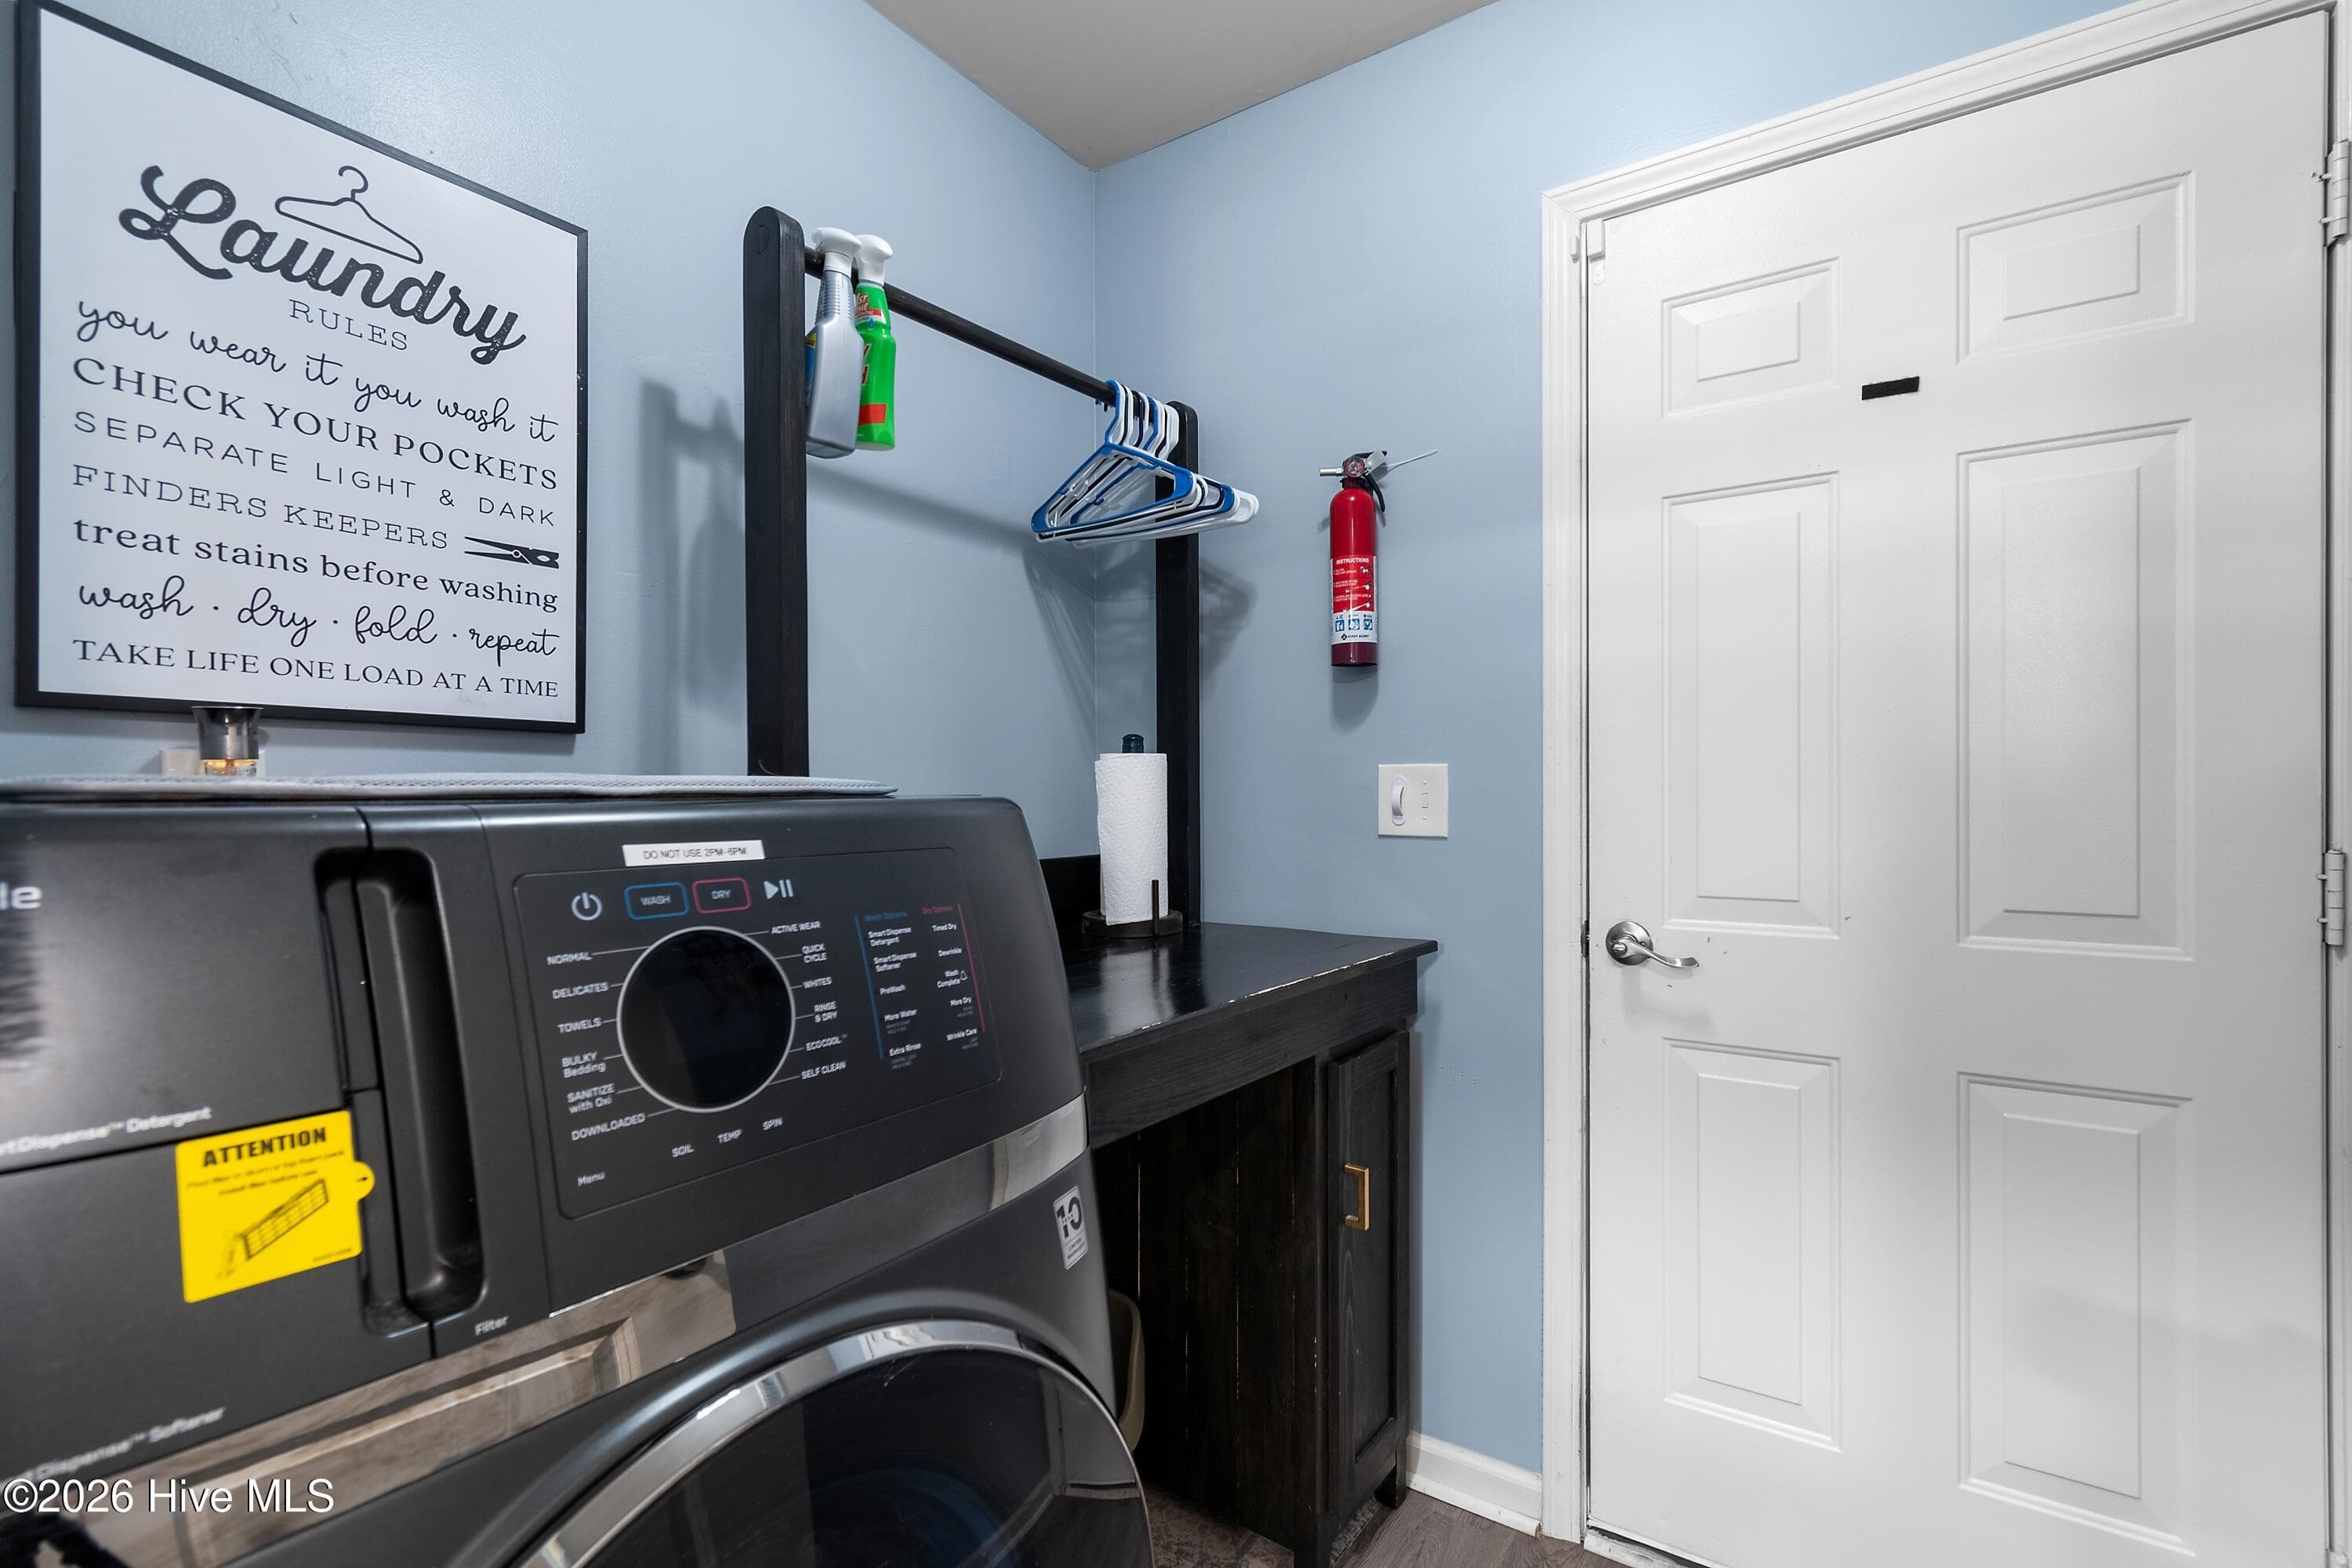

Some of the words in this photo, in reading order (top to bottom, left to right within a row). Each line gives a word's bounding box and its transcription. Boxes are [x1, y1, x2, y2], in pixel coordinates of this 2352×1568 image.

[118, 165, 526, 364] Laundry
[289, 299, 407, 350] RULES
[78, 301, 169, 342] you
[190, 330, 286, 373] wear
[306, 354, 343, 385] it
[354, 377, 422, 412] you
[437, 398, 515, 432] wash
[530, 415, 558, 441] it
[74, 358, 245, 419] CHECK
[263, 402, 379, 450] YOUR
[394, 434, 557, 489] POCKETS
[74, 412, 288, 473] SEPARATE
[317, 463, 416, 498] LIGHT
[440, 489, 455, 506] &
[480, 497, 554, 526] DARK
[74, 465, 267, 517] FINDERS
[284, 505, 448, 549] KEEPERS
[74, 520, 180, 555] treat
[195, 538, 308, 574] stains
[320, 555, 429, 590] before
[439, 579, 558, 613] washing
[79, 575, 194, 619] wash
[238, 587, 317, 647] dry
[355, 605, 437, 644] fold
[469, 629, 560, 667] repeat
[73, 640, 175, 666] TAKE
[187, 650, 259, 673] LIFE
[270, 658, 334, 680] ONE
[344, 664, 423, 686] LOAD
[433, 673, 466, 690] AT
[474, 676, 492, 691] A
[501, 678, 558, 697] TIME
[643, 851, 658, 859] DO
[661, 849, 681, 858] NOT
[684, 848, 702, 858] USE
[641, 895, 671, 906] WASH
[711, 890, 731, 899] DRY
[771, 924, 798, 935] ACTIVE
[799, 920, 821, 931] WEAR
[802, 943, 826, 954] QUICK
[869, 937, 899, 946] Detergent
[546, 951, 593, 965] NORMAL
[804, 953, 828, 963] CYCLE
[876, 963, 901, 972] Softener
[945, 969, 959, 978] Wash
[552, 982, 609, 999] DELICATES
[803, 977, 833, 989] WHITES
[937, 978, 960, 988] Complete
[814, 1001, 837, 1012] RINSE
[899, 1009, 916, 1018] Water
[822, 1011, 838, 1022] DRY
[557, 1018, 602, 1033] TOWELS
[946, 1031, 965, 1041] Wrinkle
[966, 1028, 978, 1036] Care
[889, 1047, 905, 1056] Extra
[906, 1043, 921, 1051] Rinse
[561, 1051, 597, 1067] BULKY
[564, 1062, 606, 1078] Bedding
[801, 1067, 820, 1079] SELF
[822, 1061, 847, 1074] CLEAN
[567, 1083, 615, 1102] SANITIZE
[569, 1101, 593, 1113] with
[595, 1095, 612, 1107] Oxi
[126, 1106, 212, 1133] Detergent
[572, 1112, 646, 1141] DOWNLOADED
[763, 1117, 782, 1131] SPIN
[717, 1129, 742, 1143] TEMP
[203, 1127, 326, 1167] ATTENTION
[672, 1145, 695, 1157] SOIL
[578, 1172, 605, 1186] Menu
[475, 1315, 509, 1336] Filter
[149, 1406, 226, 1443] Softener
